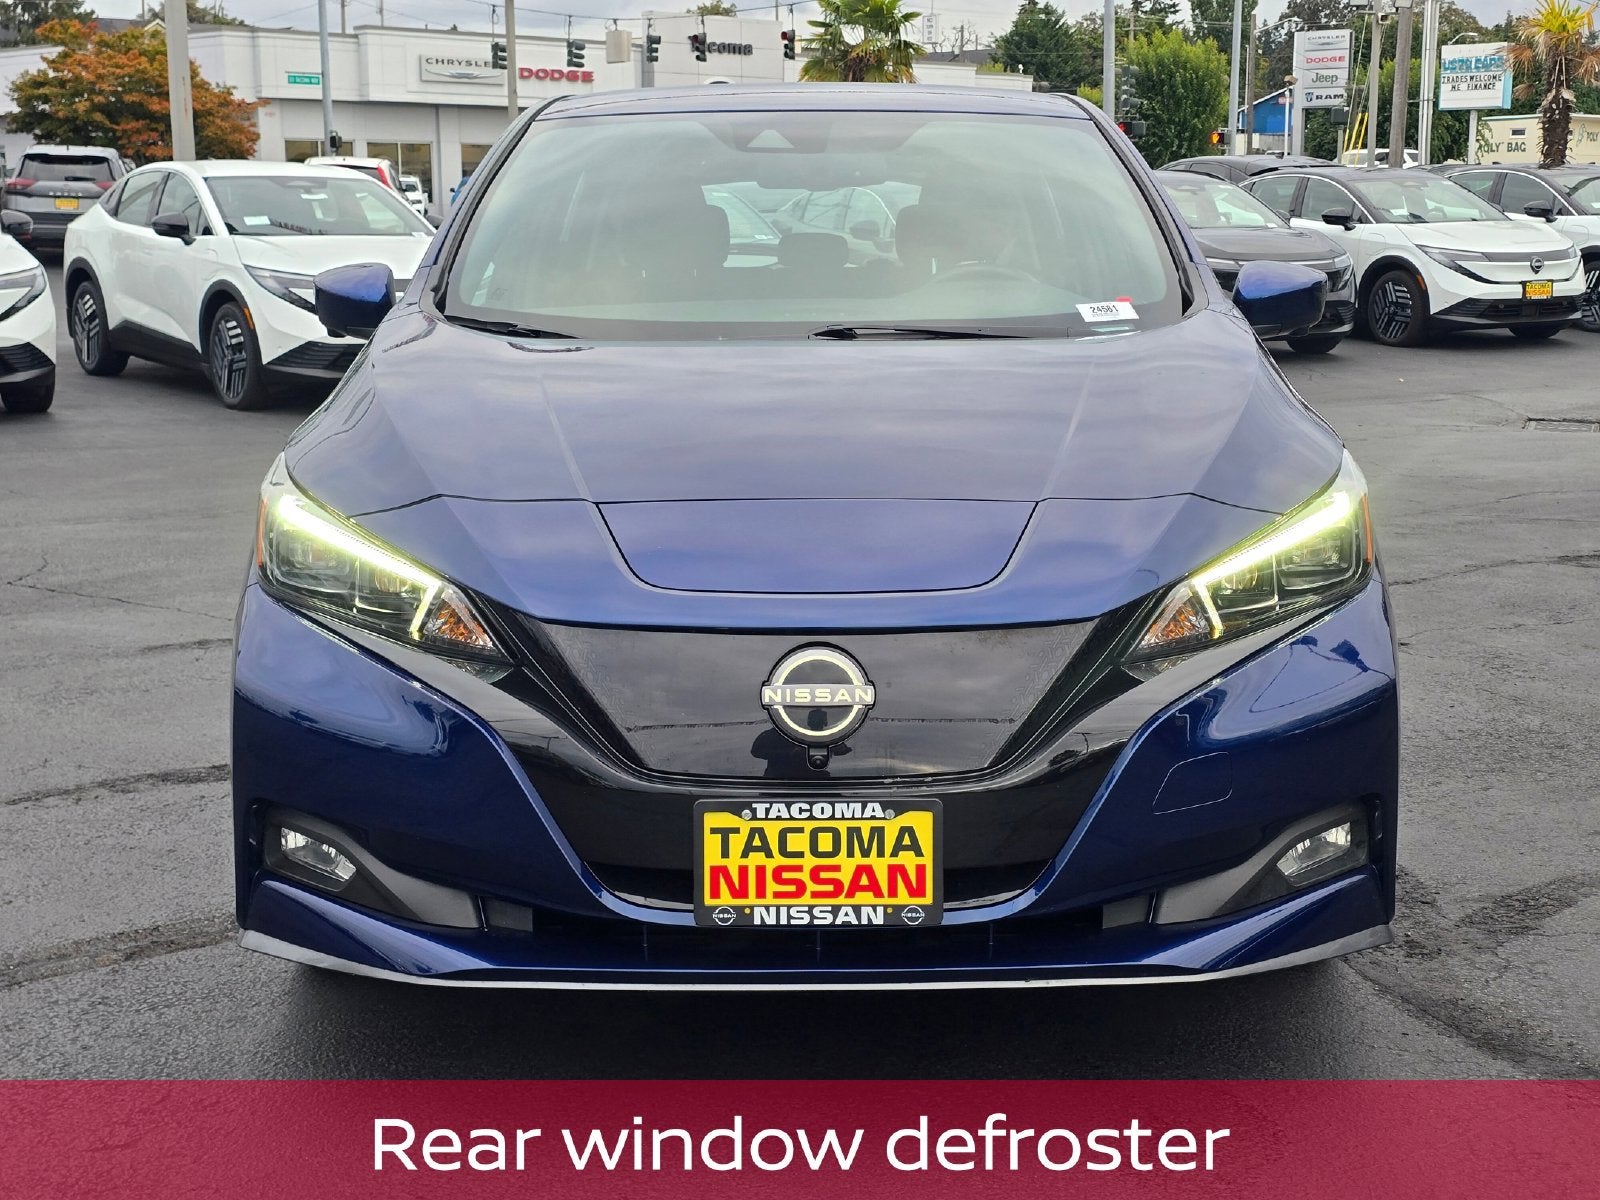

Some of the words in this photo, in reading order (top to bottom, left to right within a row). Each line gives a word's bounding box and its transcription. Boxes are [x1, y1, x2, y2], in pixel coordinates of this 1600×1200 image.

[688, 35, 753, 56] Tcoma
[425, 57, 492, 68] CHRYSLE
[1306, 56, 1345, 64] DODGE
[518, 67, 594, 83] DODGE
[1311, 72, 1339, 84] Jeep
[1442, 76, 1468, 84] TRADES
[1469, 74, 1502, 82] WELCOME
[1467, 82, 1496, 90] FINANCE
[1507, 143, 1526, 152] BAG
[764, 688, 872, 703] NISSAN
[752, 802, 885, 819] TACOMA
[709, 825, 925, 859] TACOMA
[709, 863, 927, 900] NISSAN
[753, 905, 885, 926] NISSAN
[901, 910, 926, 919] NISSAN
